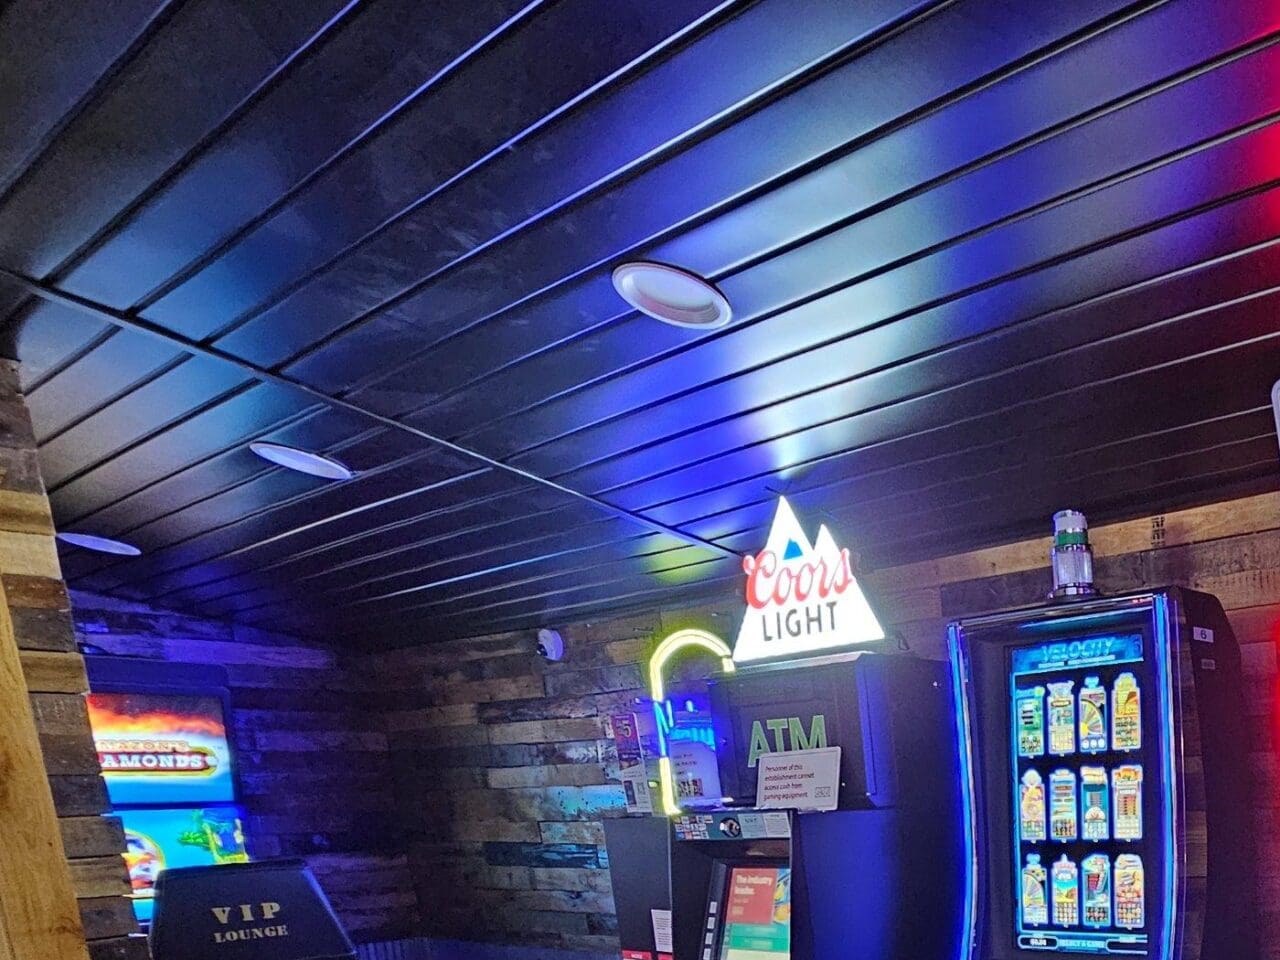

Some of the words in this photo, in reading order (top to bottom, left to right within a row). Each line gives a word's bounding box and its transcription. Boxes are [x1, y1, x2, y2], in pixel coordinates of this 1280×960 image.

[743, 547, 853, 609] Coors
[762, 601, 837, 641] LIGHT
[747, 715, 828, 768] ATM
[102, 754, 202, 768] AMONDS
[735, 874, 747, 884] The
[211, 902, 281, 924] VIP
[214, 925, 288, 943] LOUNGE
